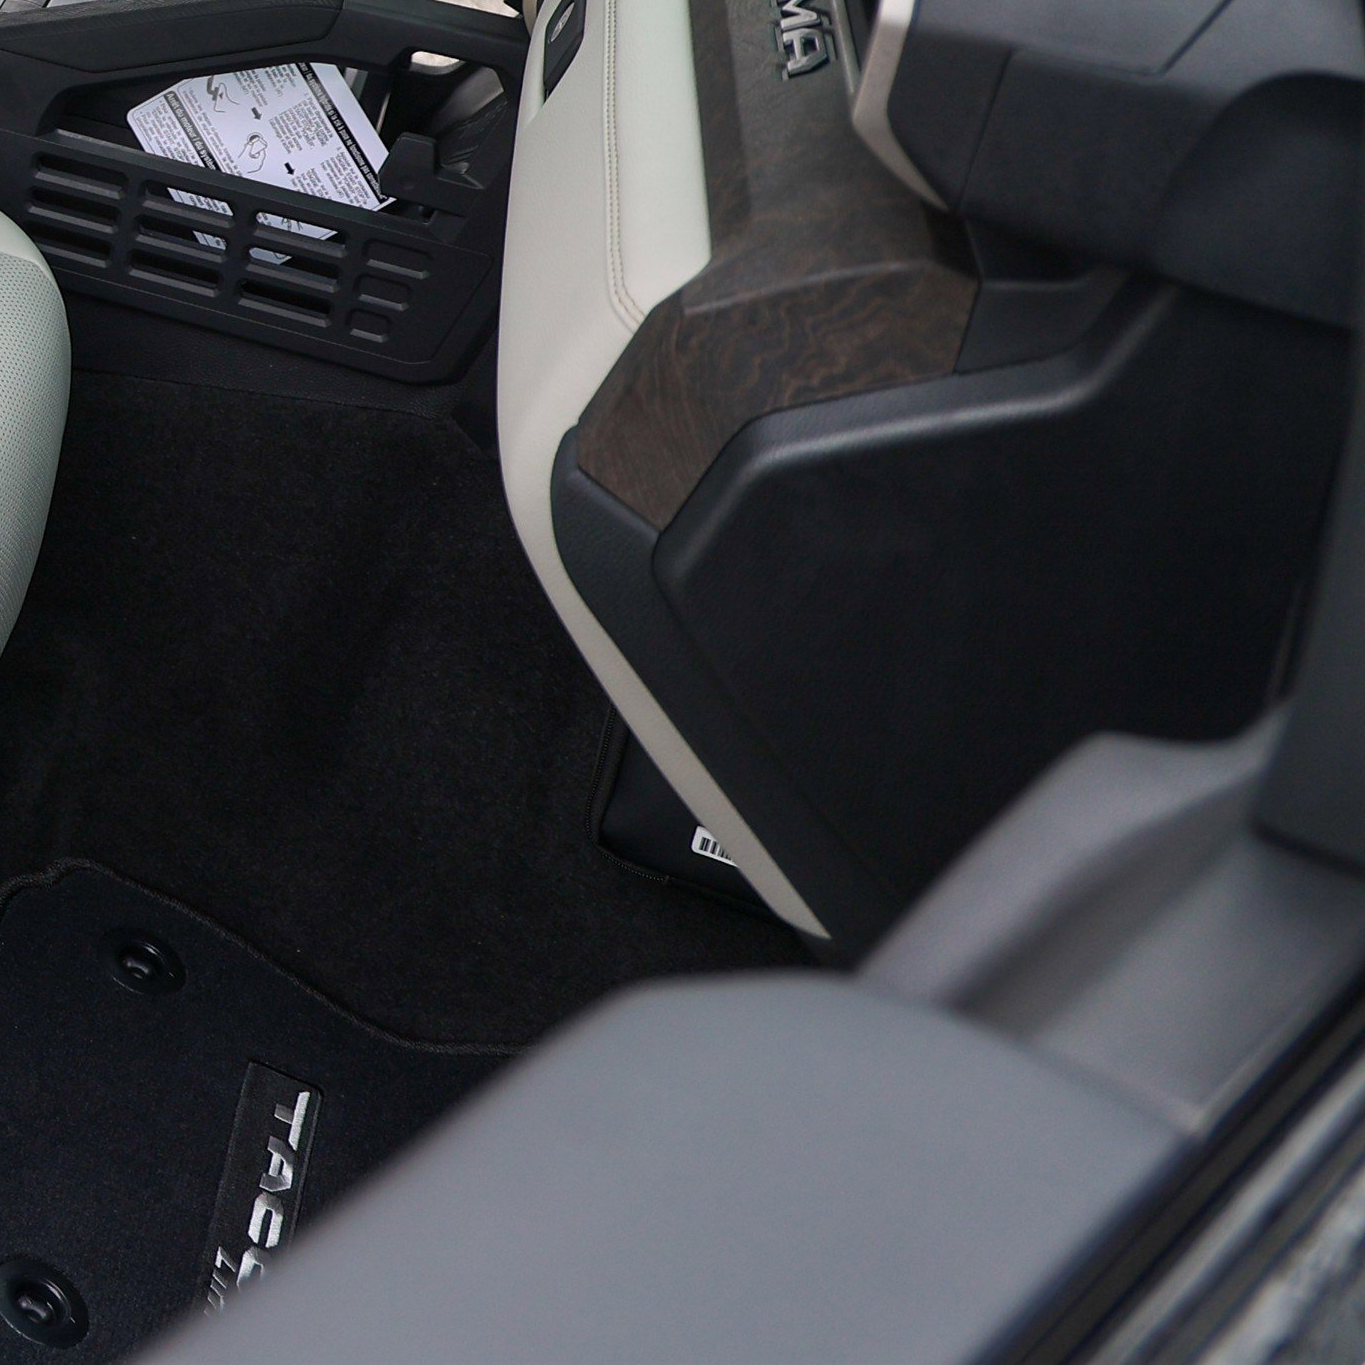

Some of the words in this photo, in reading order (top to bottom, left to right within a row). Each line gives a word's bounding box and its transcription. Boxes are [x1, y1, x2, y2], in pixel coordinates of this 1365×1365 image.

[165, 91, 181, 109] Arrêt
[174, 106, 185, 117] du
[179, 115, 198, 139] moteur
[194, 139, 205, 150] du
[197, 148, 218, 172] systèm
[236, 1091, 310, 1291] TACO
